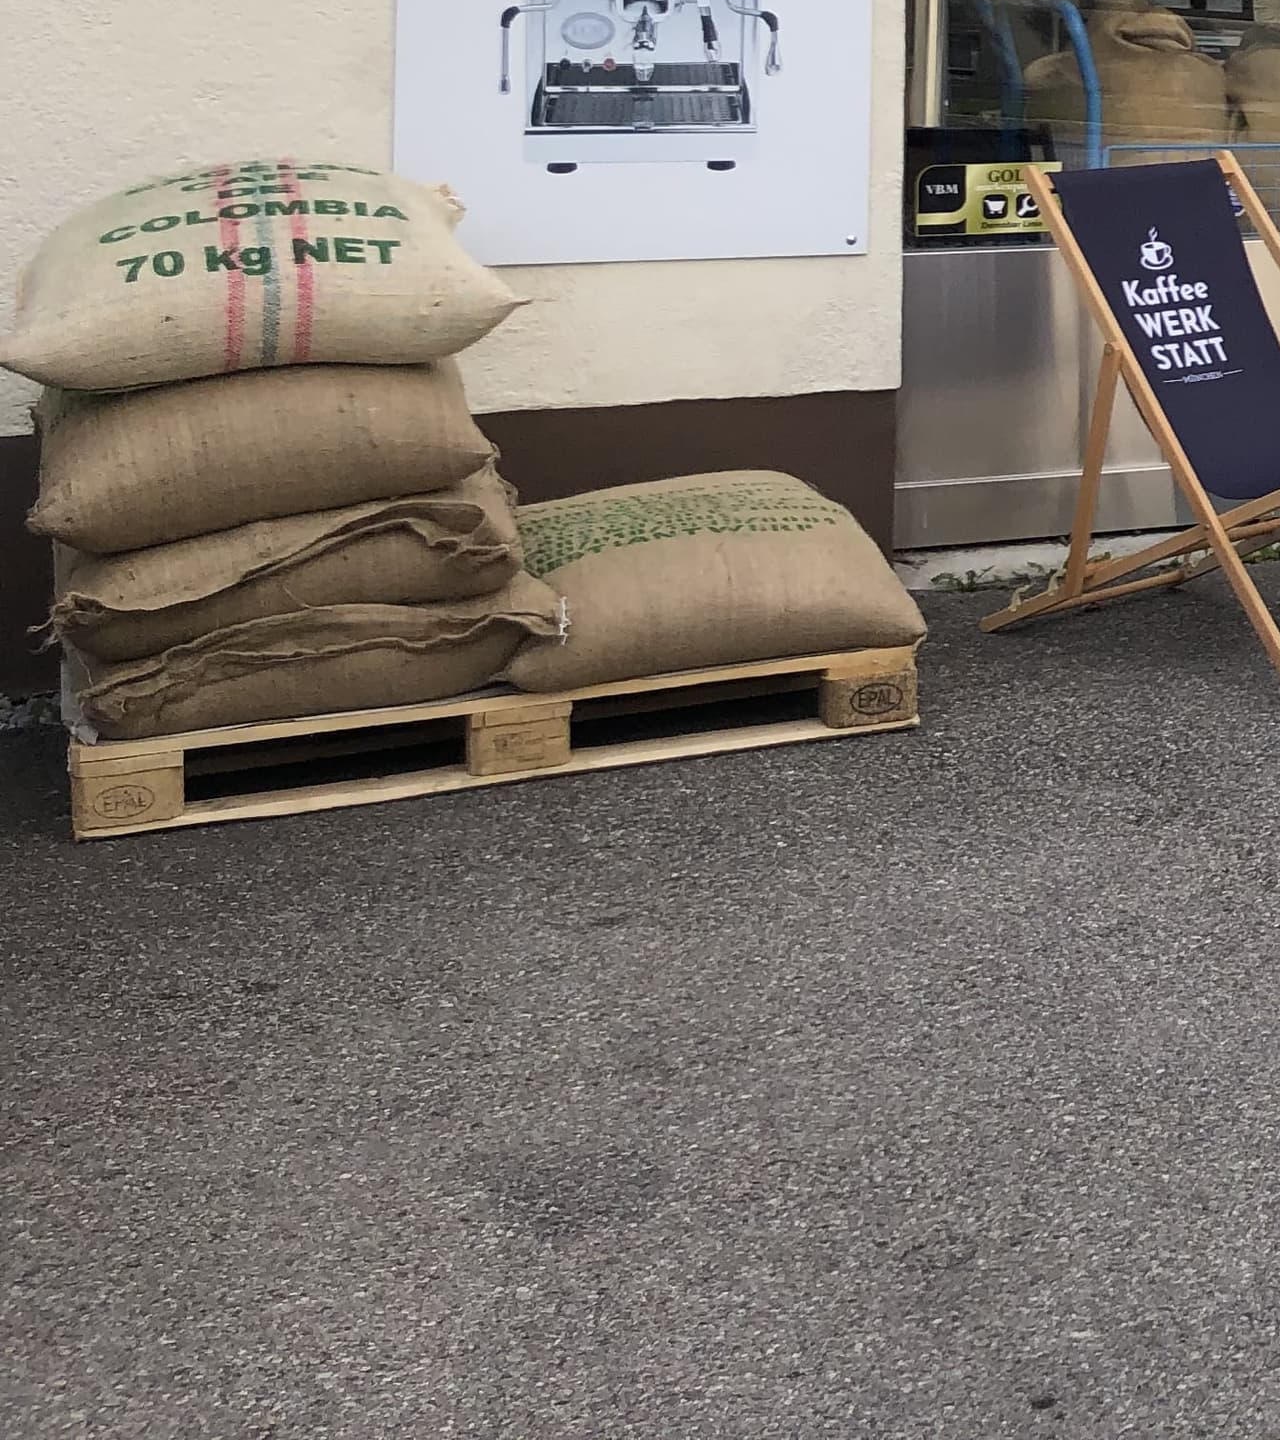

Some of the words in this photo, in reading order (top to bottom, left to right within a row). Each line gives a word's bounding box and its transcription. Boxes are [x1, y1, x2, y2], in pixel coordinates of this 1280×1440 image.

[217, 182, 296, 200] DE
[925, 183, 959, 195] VBM
[988, 169, 1026, 183] GOL
[99, 199, 409, 244] COLOMBIA
[116, 250, 185, 283] 70
[204, 245, 272, 276] kg
[292, 236, 401, 265] NET
[1122, 274, 1208, 306] Kaffee
[1134, 305, 1221, 338] WERK
[1151, 336, 1228, 370] STATT
[858, 687, 897, 708] EPAL
